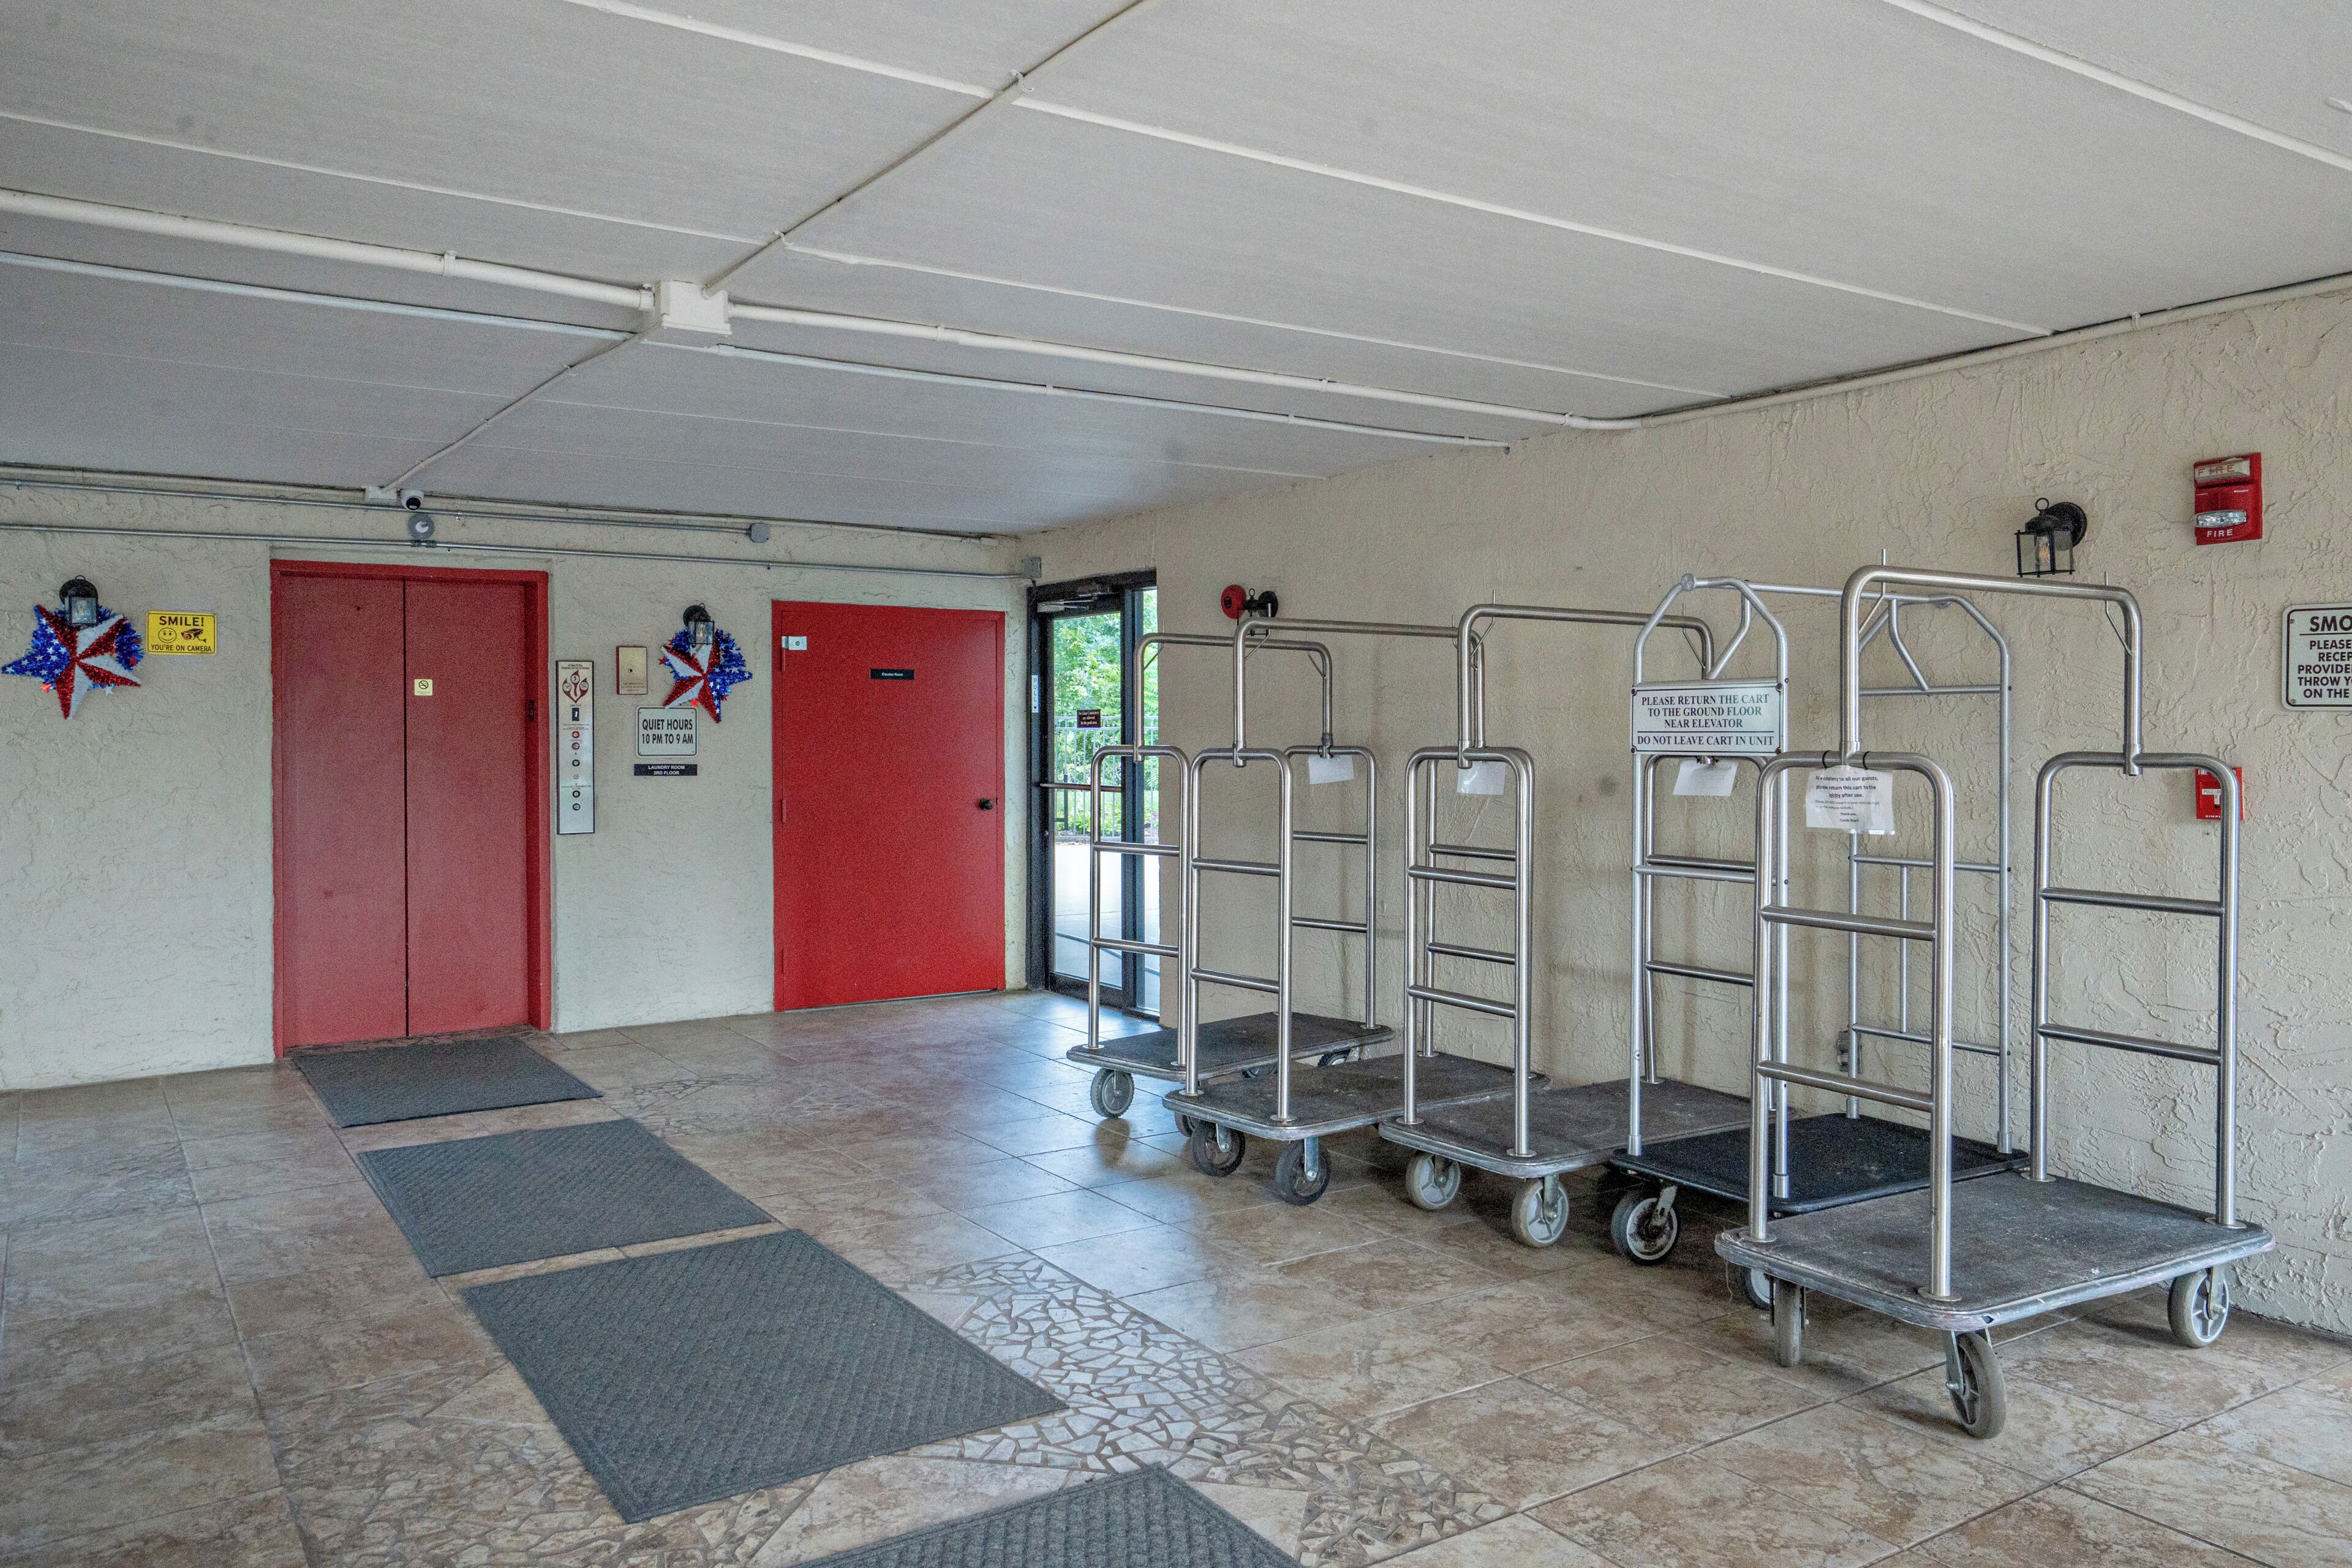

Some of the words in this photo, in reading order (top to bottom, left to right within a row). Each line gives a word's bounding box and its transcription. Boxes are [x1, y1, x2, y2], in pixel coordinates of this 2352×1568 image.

[2198, 464, 2234, 476] FIRE
[2207, 529, 2233, 537] FIRE
[159, 616, 204, 627] SMILE!
[2310, 615, 2352, 632] SMO
[2310, 639, 2351, 650] PLEASE
[2298, 665, 2352, 674] PROVIDE
[2298, 677, 2340, 686] THROW
[2344, 677, 2352, 686] Y
[2304, 688, 2323, 698] ON
[2327, 688, 2350, 698] THE
[1642, 696, 1675, 706] PLEASE
[1678, 695, 1716, 704] RETURN
[1719, 695, 1739, 704] THE
[1741, 694, 1769, 703] CART
[1648, 708, 1660, 717] TO
[1662, 707, 1681, 716] THE
[1683, 707, 1724, 716] GROUND
[1727, 706, 1762, 715] FLOOR
[643, 719, 665, 731] QUIET
[666, 719, 693, 731] HOURS
[1665, 719, 1689, 728] NEAR
[1692, 718, 1743, 728] ELEVATOR
[642, 734, 649, 744] 10
[652, 734, 663, 744] PM
[665, 734, 674, 744] TO
[676, 734, 680, 744] 9
[682, 734, 693, 744] AM
[1638, 736, 1650, 745] DO
[1653, 736, 1672, 745] NOT
[1675, 736, 1704, 745] LEAVE
[1707, 736, 1733, 745] CART
[1736, 736, 1746, 745] IN
[1749, 736, 1774, 745] UNIT
